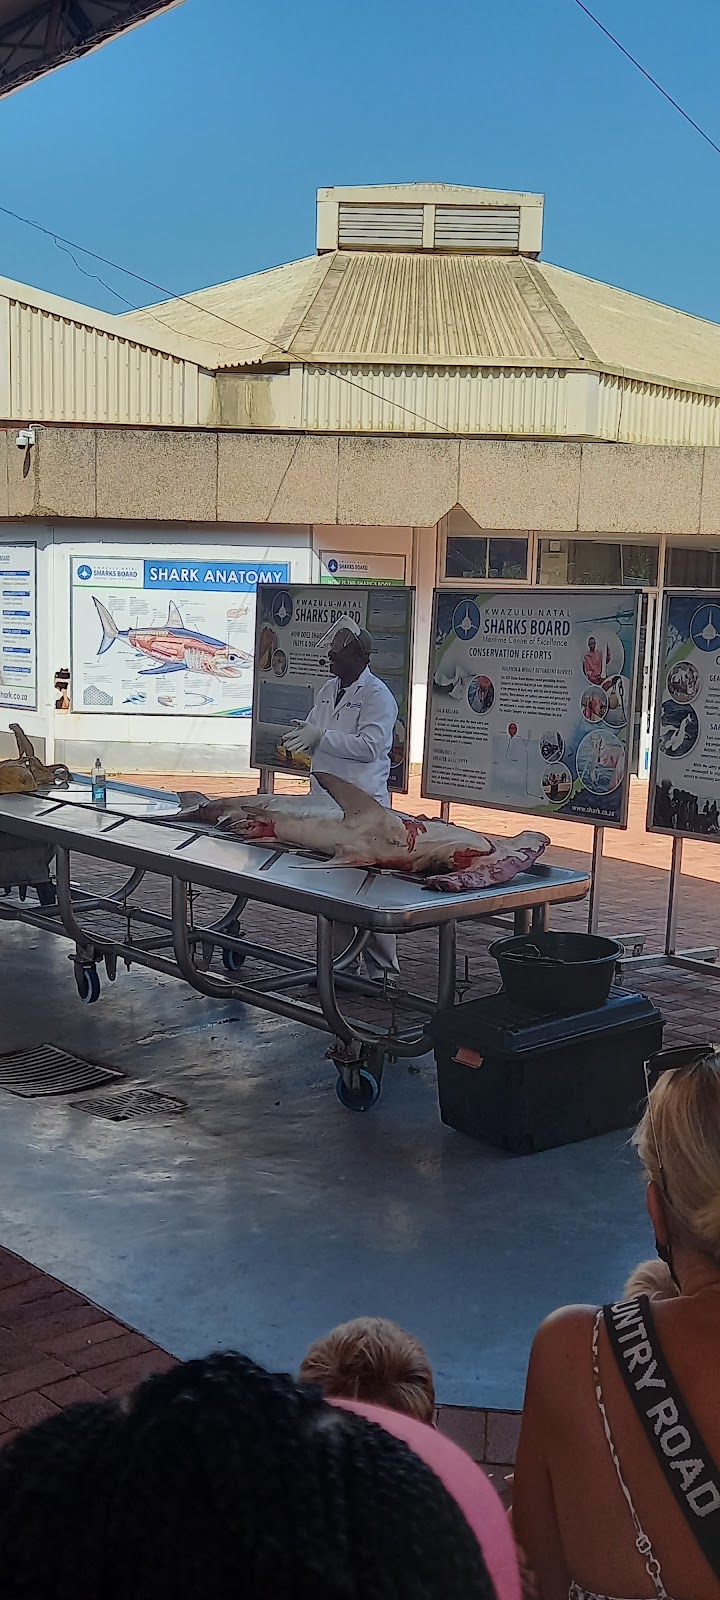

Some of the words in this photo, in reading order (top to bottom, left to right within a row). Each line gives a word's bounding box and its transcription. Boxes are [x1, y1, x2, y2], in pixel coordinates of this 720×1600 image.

[149, 567, 199, 582] SHARK
[203, 568, 283, 584] ANATOMY
[296, 600, 362, 608] KWAZULU-NATAL
[295, 608, 328, 623] SHARKS
[330, 609, 361, 625] BORD
[484, 608, 571, 618] KWAZULU-NATAL
[483, 618, 527, 635] SHARKS
[530, 619, 570, 636] BOARD
[508, 636, 527, 645] Centre
[529, 636, 536, 645] of
[537, 637, 567, 647] Excellence
[469, 647, 519, 658] CONSERVATION
[521, 649, 552, 660] EFFORTS
[571, 805, 614, 816] www.shark.co.za
[646, 1396, 720, 1517] ROAD
